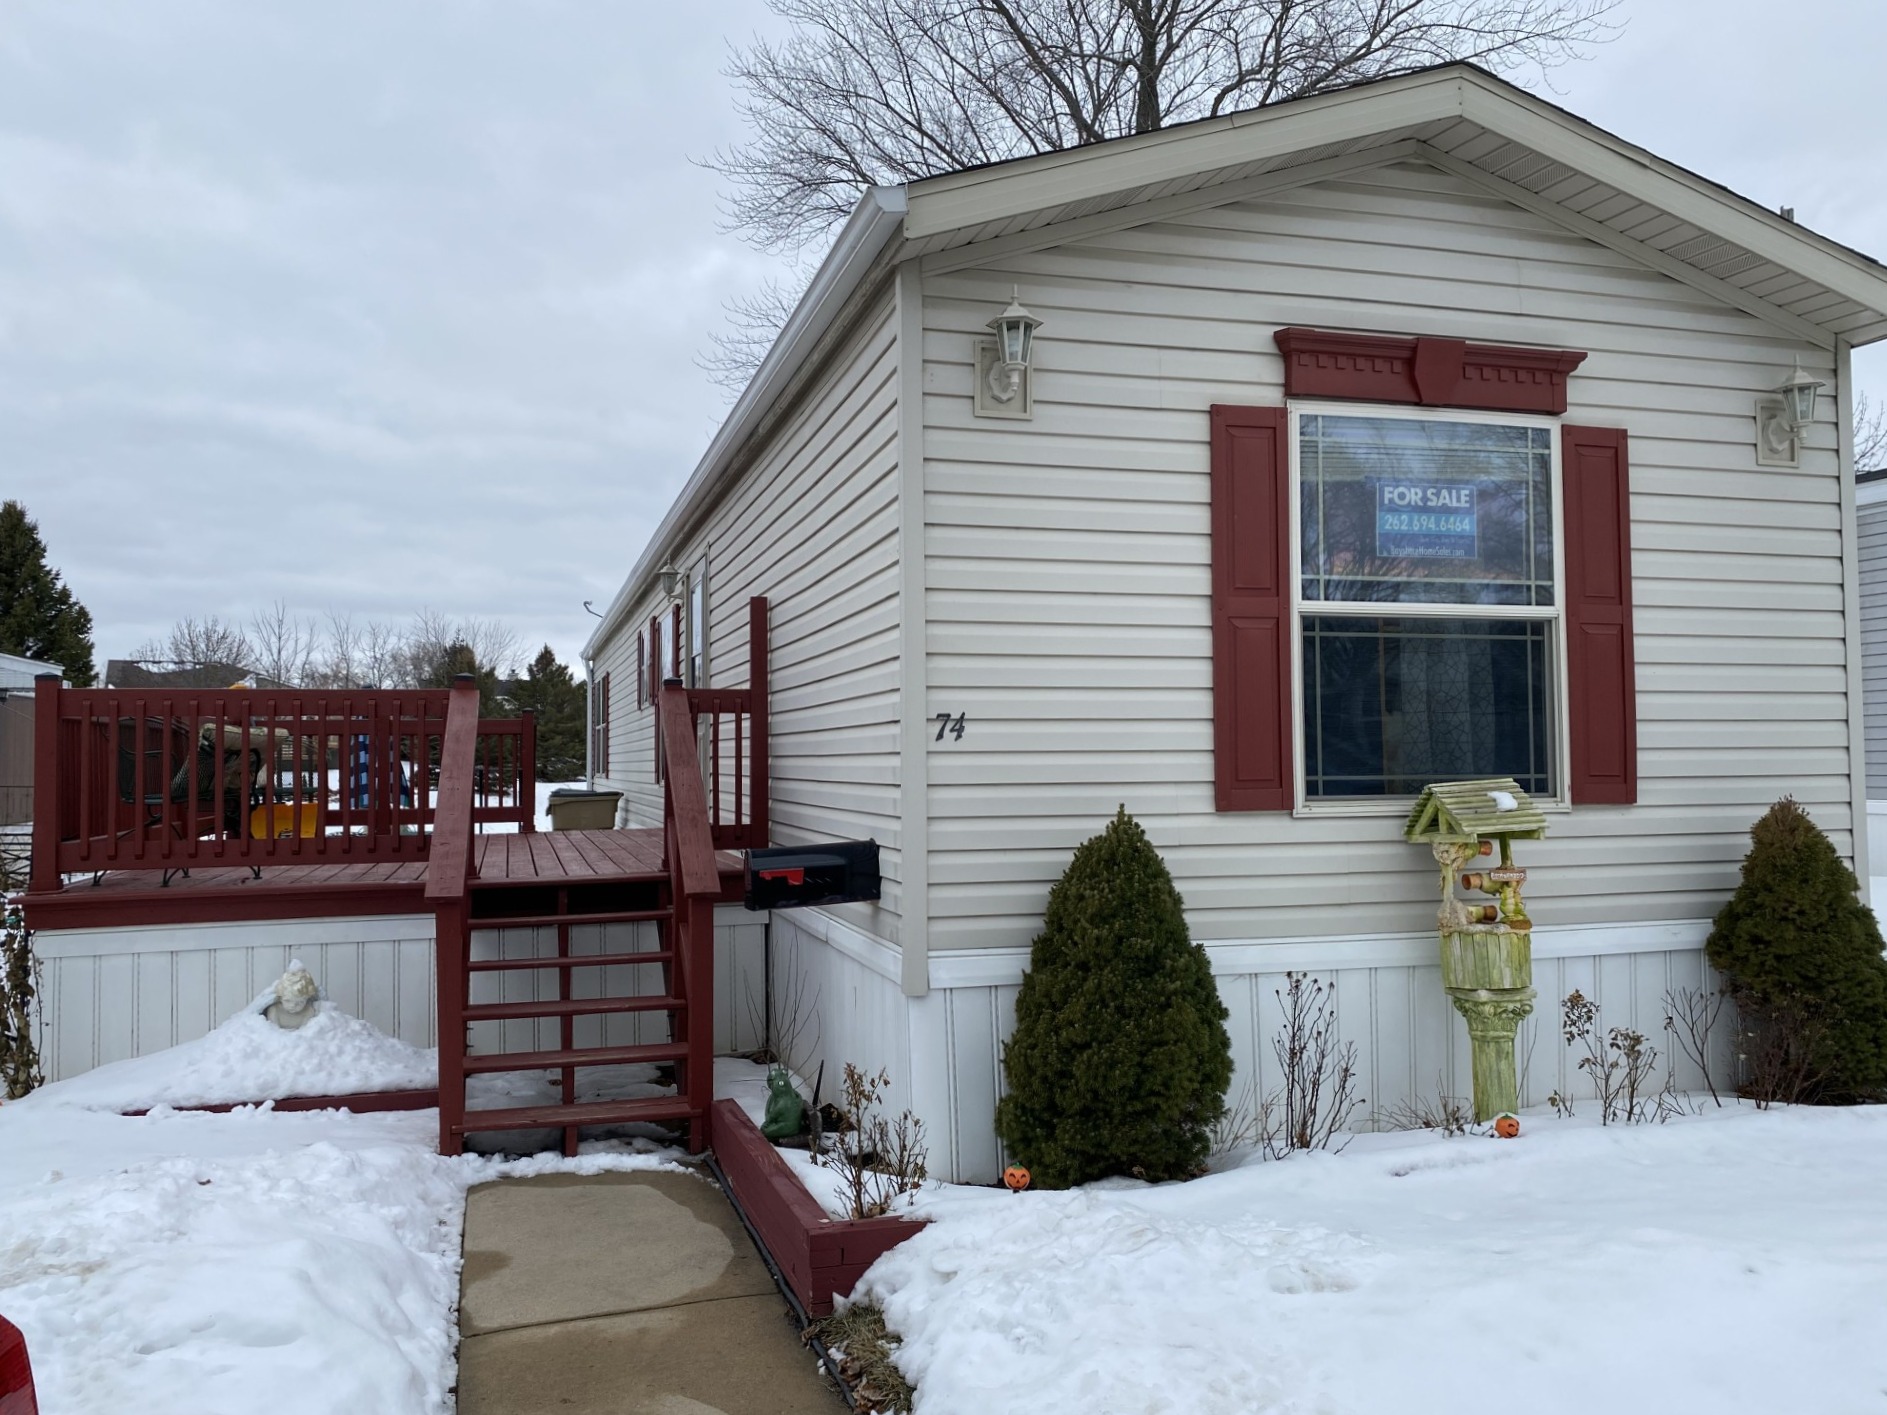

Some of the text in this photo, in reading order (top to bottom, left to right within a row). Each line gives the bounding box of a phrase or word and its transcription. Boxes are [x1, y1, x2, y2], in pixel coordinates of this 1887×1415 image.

[1384, 486, 1470, 507] FOR SALE
[1384, 514, 1470, 532] 262.694.6464
[935, 711, 965, 742] 74
